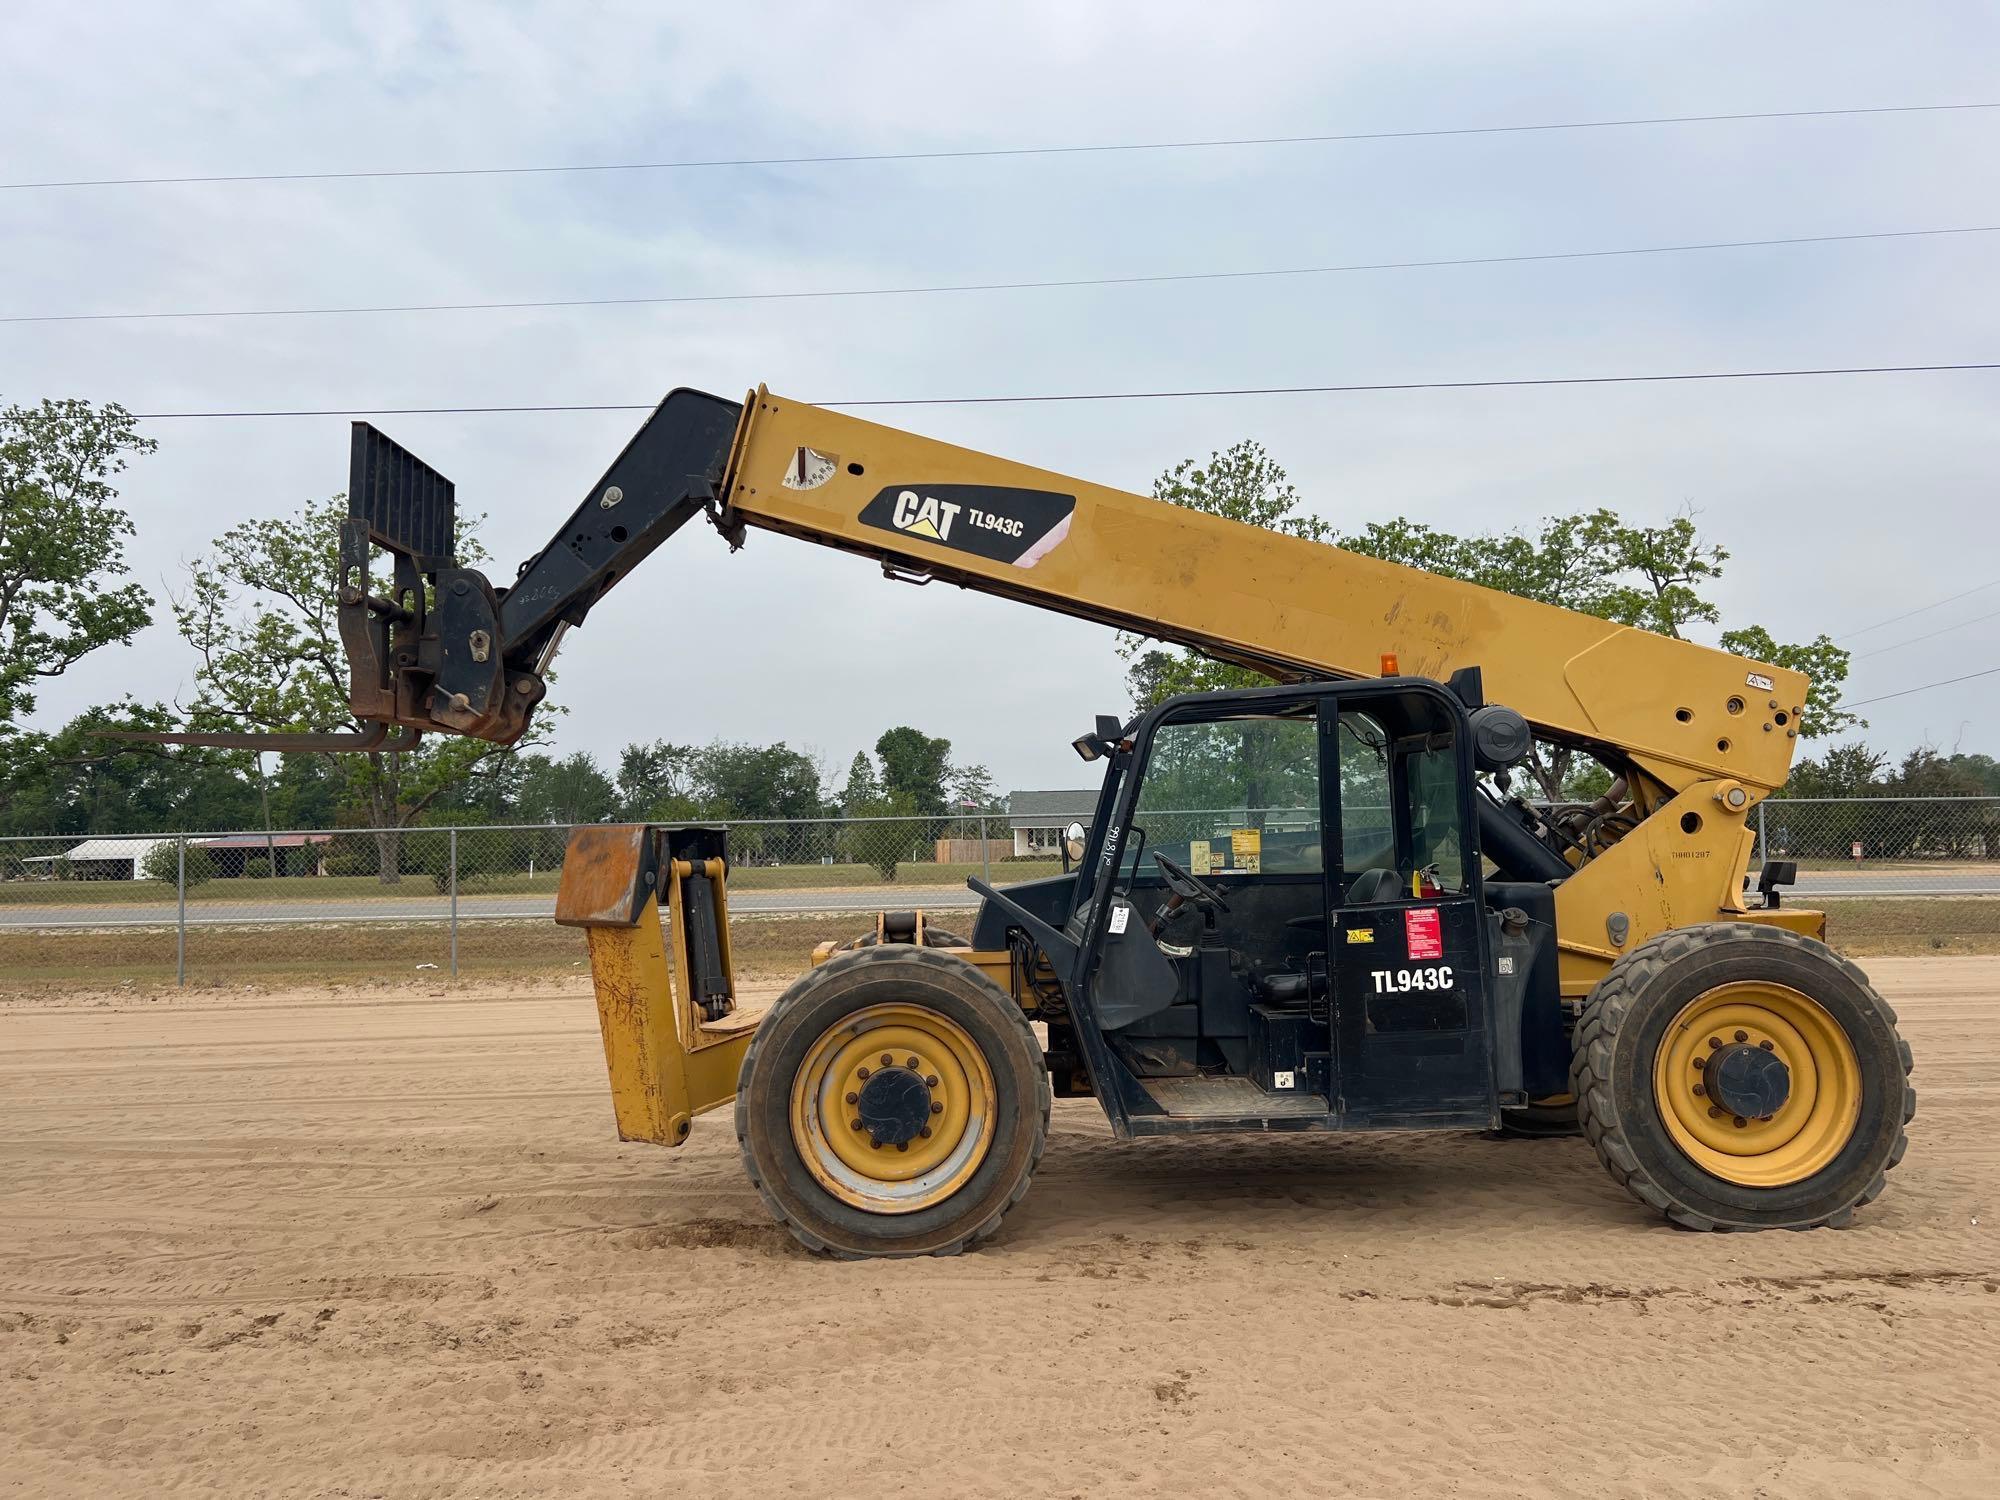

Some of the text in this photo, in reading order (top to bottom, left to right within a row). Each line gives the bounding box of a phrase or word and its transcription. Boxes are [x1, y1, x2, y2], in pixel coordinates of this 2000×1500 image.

[892, 490, 1024, 541] CAT TL943C
[1371, 966, 1454, 993] TL943C
